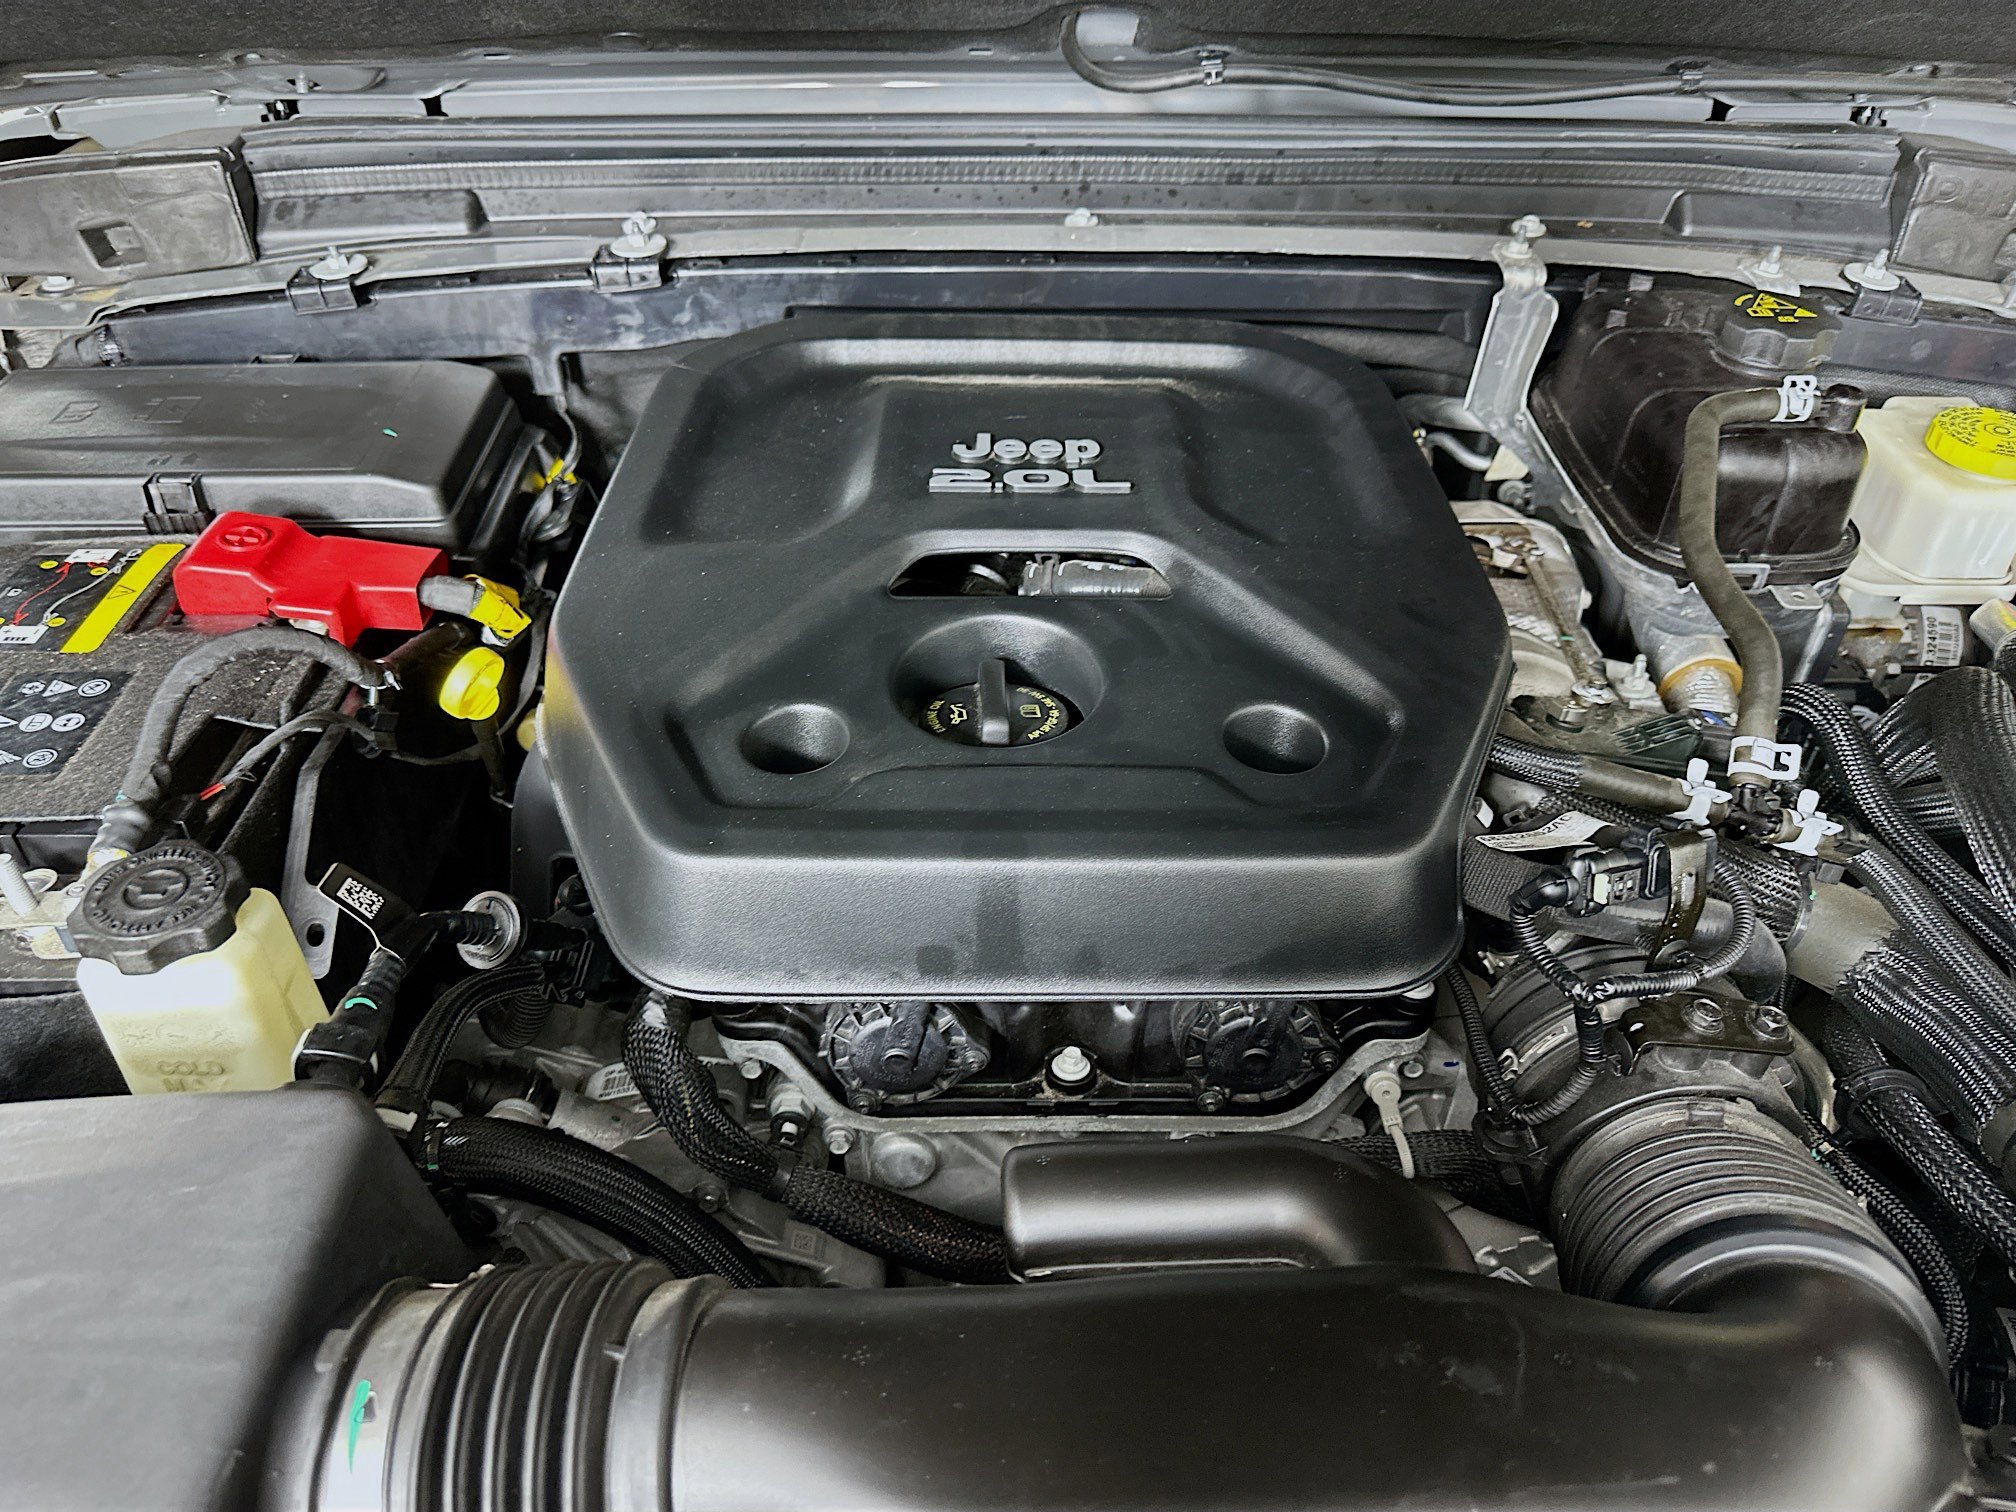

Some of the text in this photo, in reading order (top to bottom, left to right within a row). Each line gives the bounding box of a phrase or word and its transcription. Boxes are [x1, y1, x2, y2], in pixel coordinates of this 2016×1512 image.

[952, 433, 1101, 468] Jeep
[929, 468, 1132, 494] 2.0L
[927, 700, 946, 734] ENGINE OIL
[1027, 731, 1041, 740] API
[157, 1060, 225, 1076] COLD
